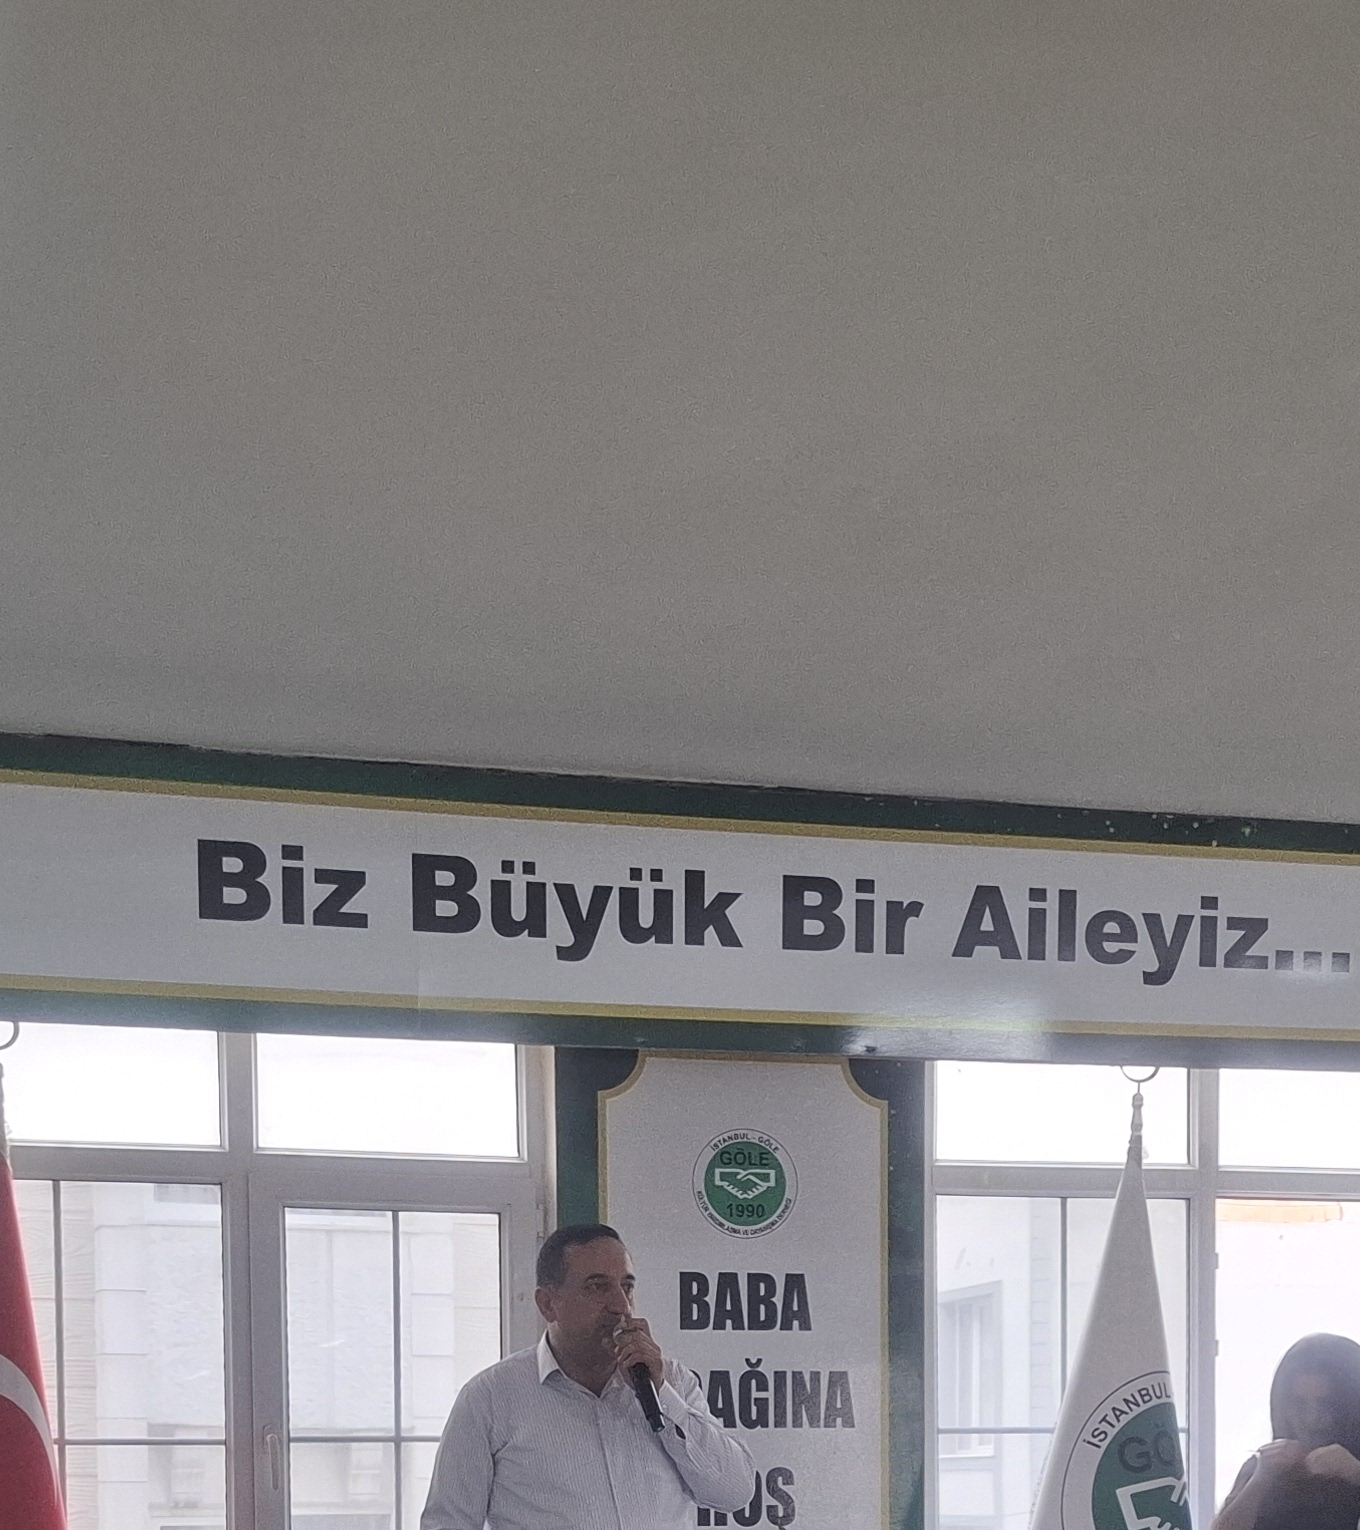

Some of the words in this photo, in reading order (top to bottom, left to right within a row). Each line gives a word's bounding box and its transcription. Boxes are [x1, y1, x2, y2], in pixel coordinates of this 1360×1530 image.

[197, 839, 368, 929] Biz
[412, 853, 744, 962] Büyük
[782, 874, 925, 955] Bir
[951, 884, 1351, 986] Aileyiz...
[709, 1132, 752, 1152] İSTANBUL
[758, 1136, 780, 1154] GÖLE
[720, 1147, 769, 1166] GÖLE
[726, 1203, 765, 1218] 1990
[679, 1271, 813, 1331] BABA
[690, 1358, 855, 1429] AĞINA
[1083, 1382, 1171, 1450] İSTANBUL
